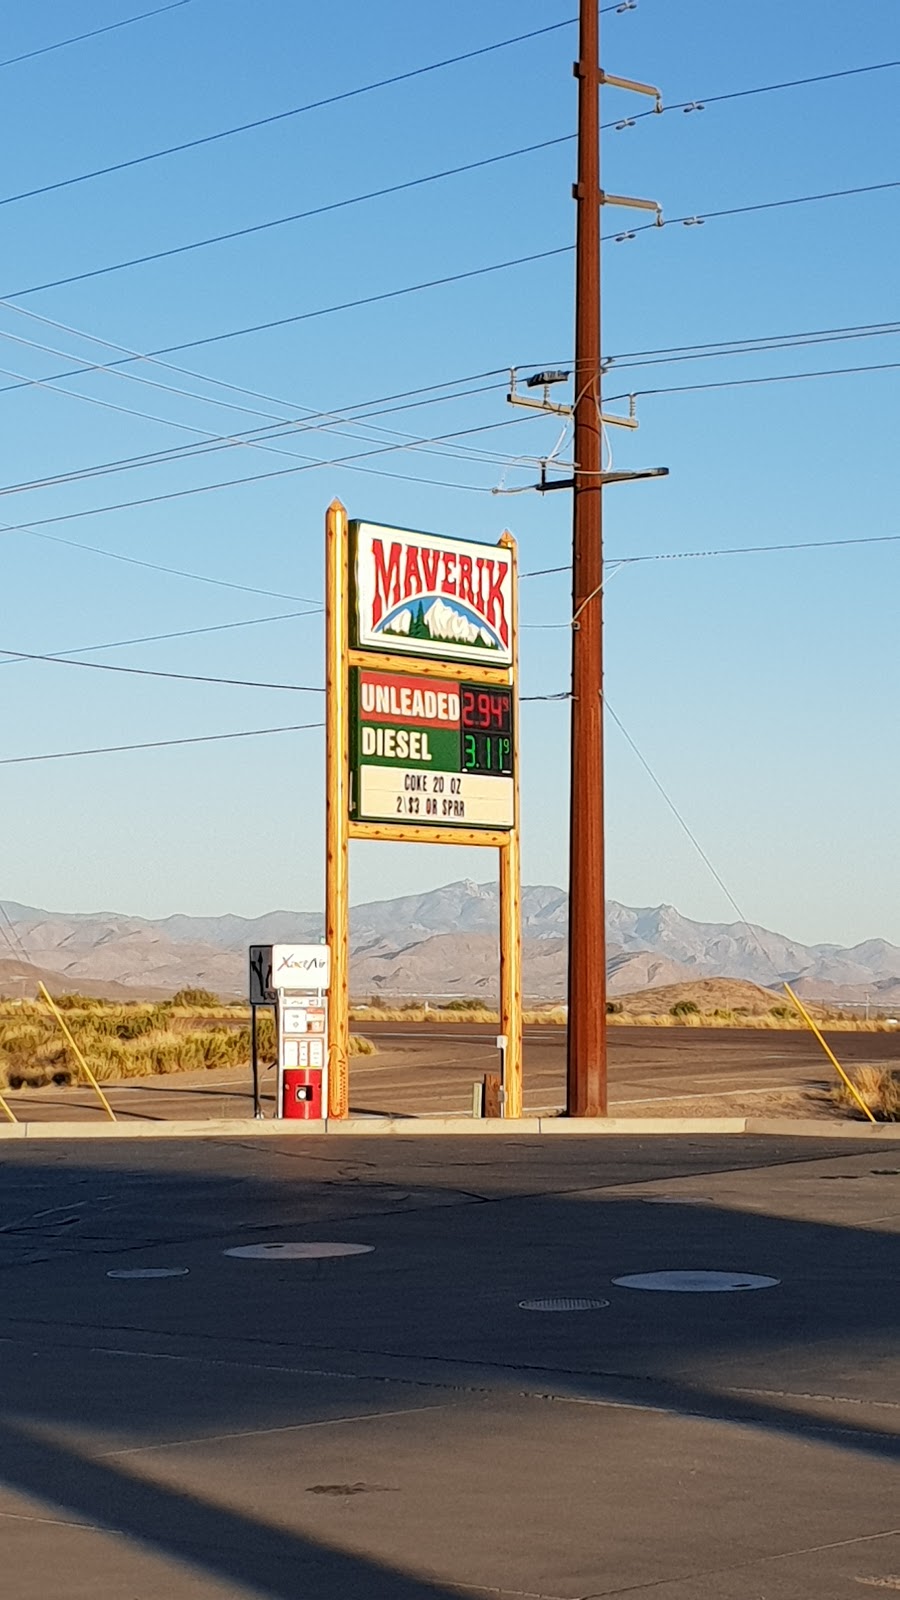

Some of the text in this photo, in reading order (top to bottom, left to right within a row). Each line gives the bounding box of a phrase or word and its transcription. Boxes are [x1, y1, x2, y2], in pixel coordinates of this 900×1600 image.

[371, 538, 508, 649] MAVERIK
[361, 682, 461, 722] UNLEADED
[361, 726, 433, 761] DIESEL
[404, 773, 462, 795] COKE 20 OZ
[426, 797, 438, 815] OR
